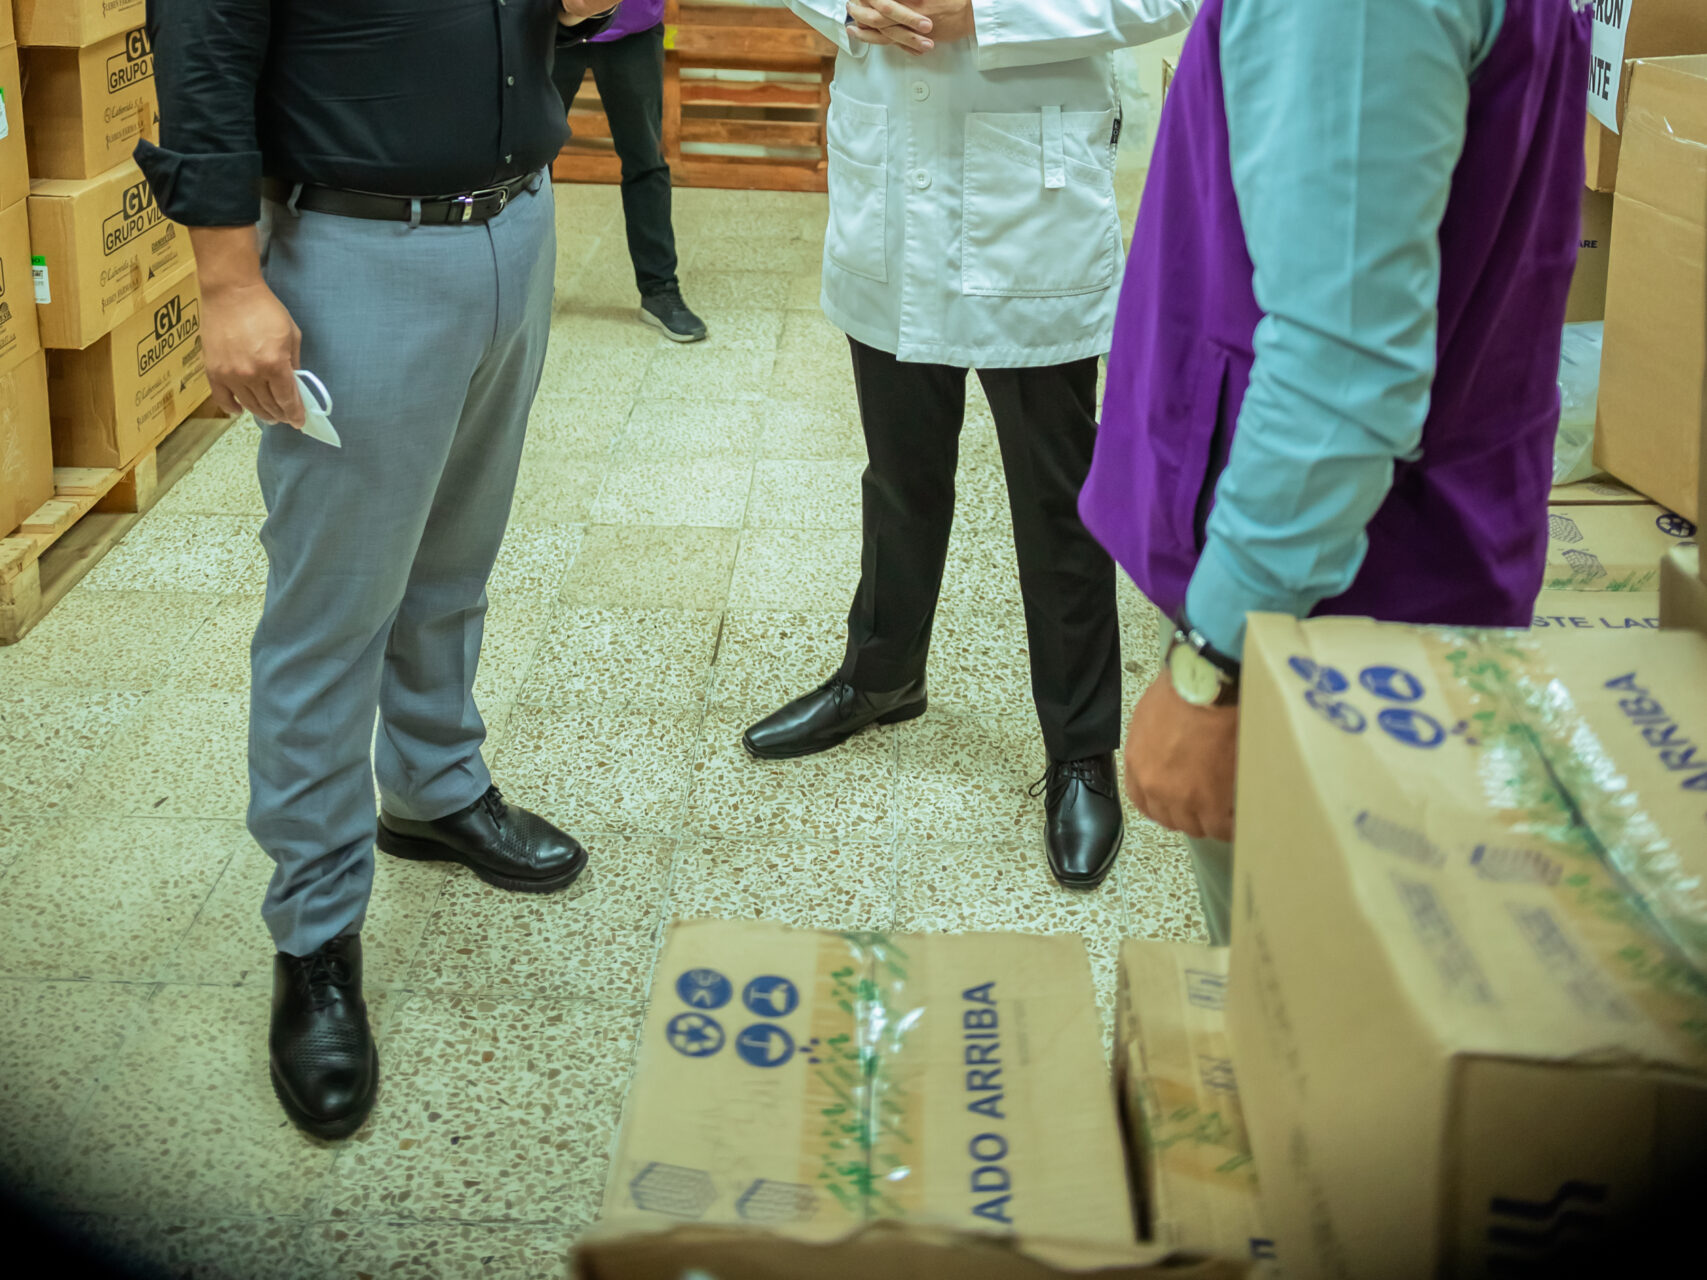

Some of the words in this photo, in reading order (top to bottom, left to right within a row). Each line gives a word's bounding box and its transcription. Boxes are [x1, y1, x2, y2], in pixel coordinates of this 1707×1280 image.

[128, 27, 151, 58] GV
[110, 59, 148, 89] GRUPO
[1589, 55, 1611, 101] NTE
[126, 183, 150, 216] GV
[106, 215, 144, 251] GRUPO
[156, 298, 180, 336] GV
[140, 332, 175, 371] GRUPO
[176, 314, 198, 340] VIDA
[1533, 616, 1594, 628] STE
[962, 981, 1005, 1120] ARRIBA
[969, 1132, 1013, 1224] ADO
